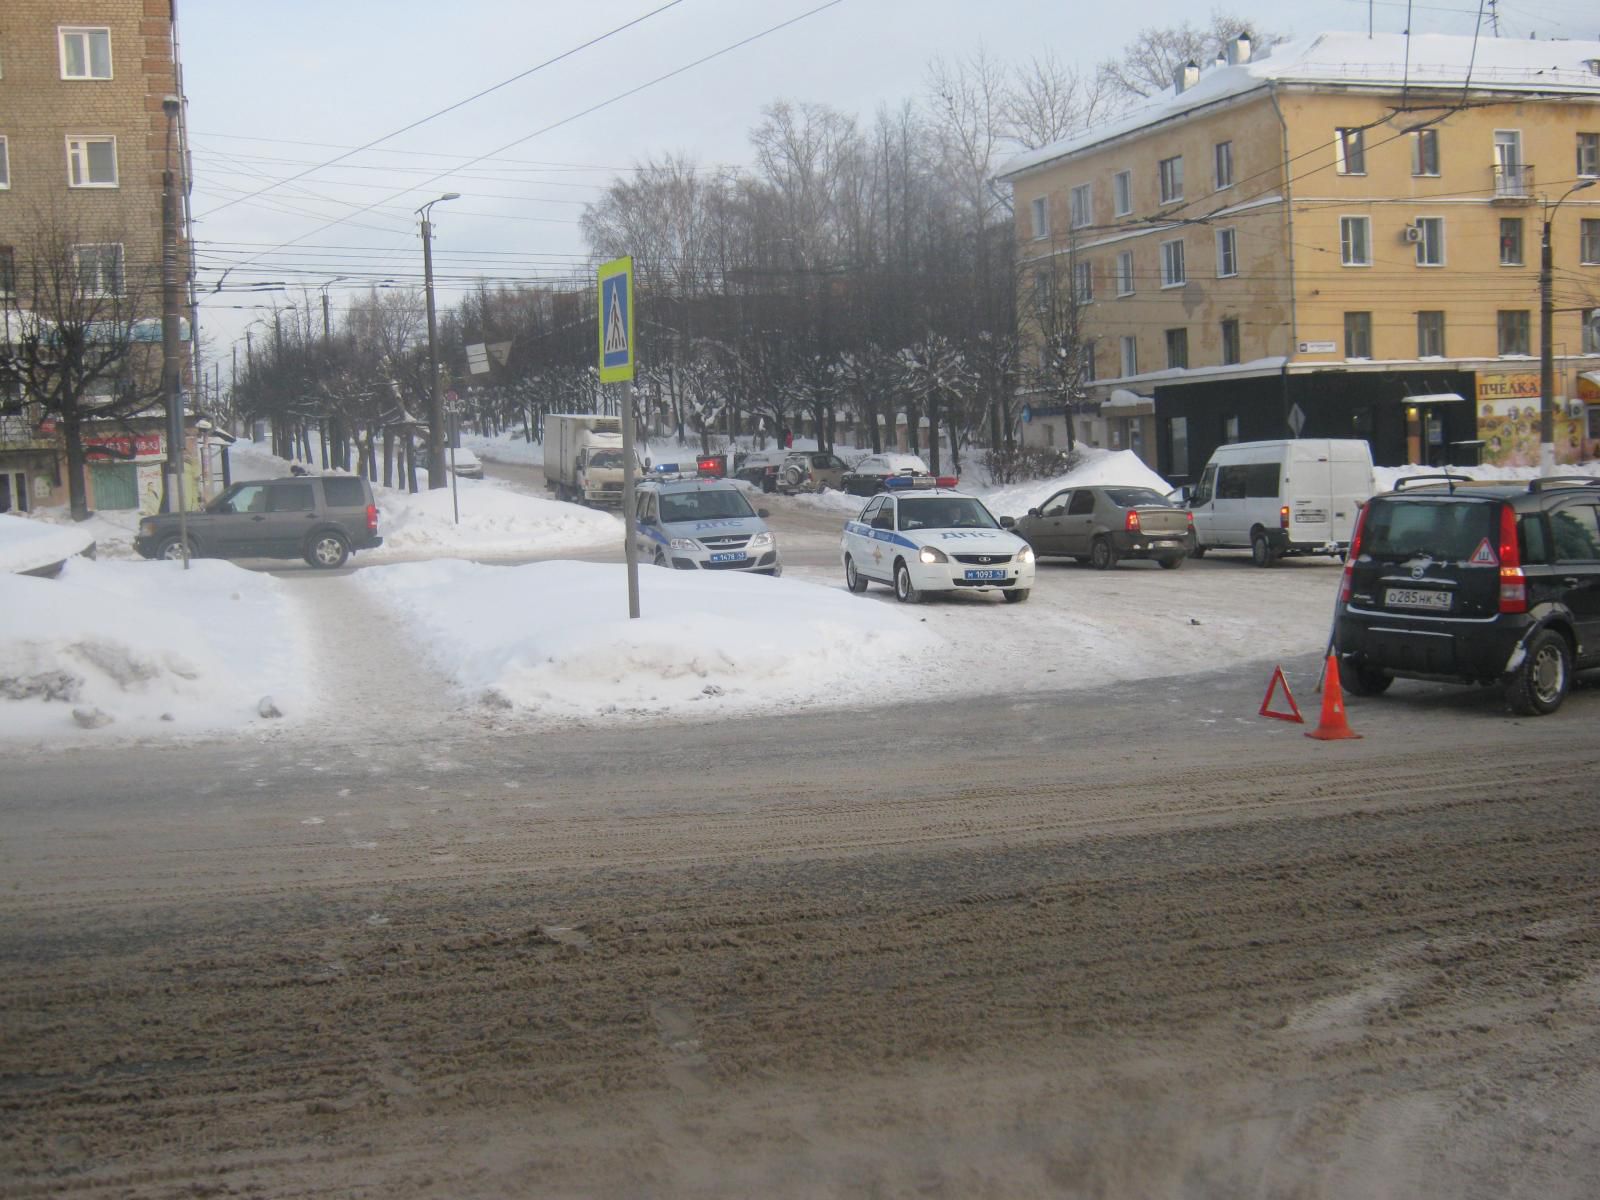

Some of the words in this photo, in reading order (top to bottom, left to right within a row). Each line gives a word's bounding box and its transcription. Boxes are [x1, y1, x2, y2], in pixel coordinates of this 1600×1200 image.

[695, 519, 743, 530] ДПС
[940, 531, 997, 540] ДПС
[975, 570, 993, 578] 1093
